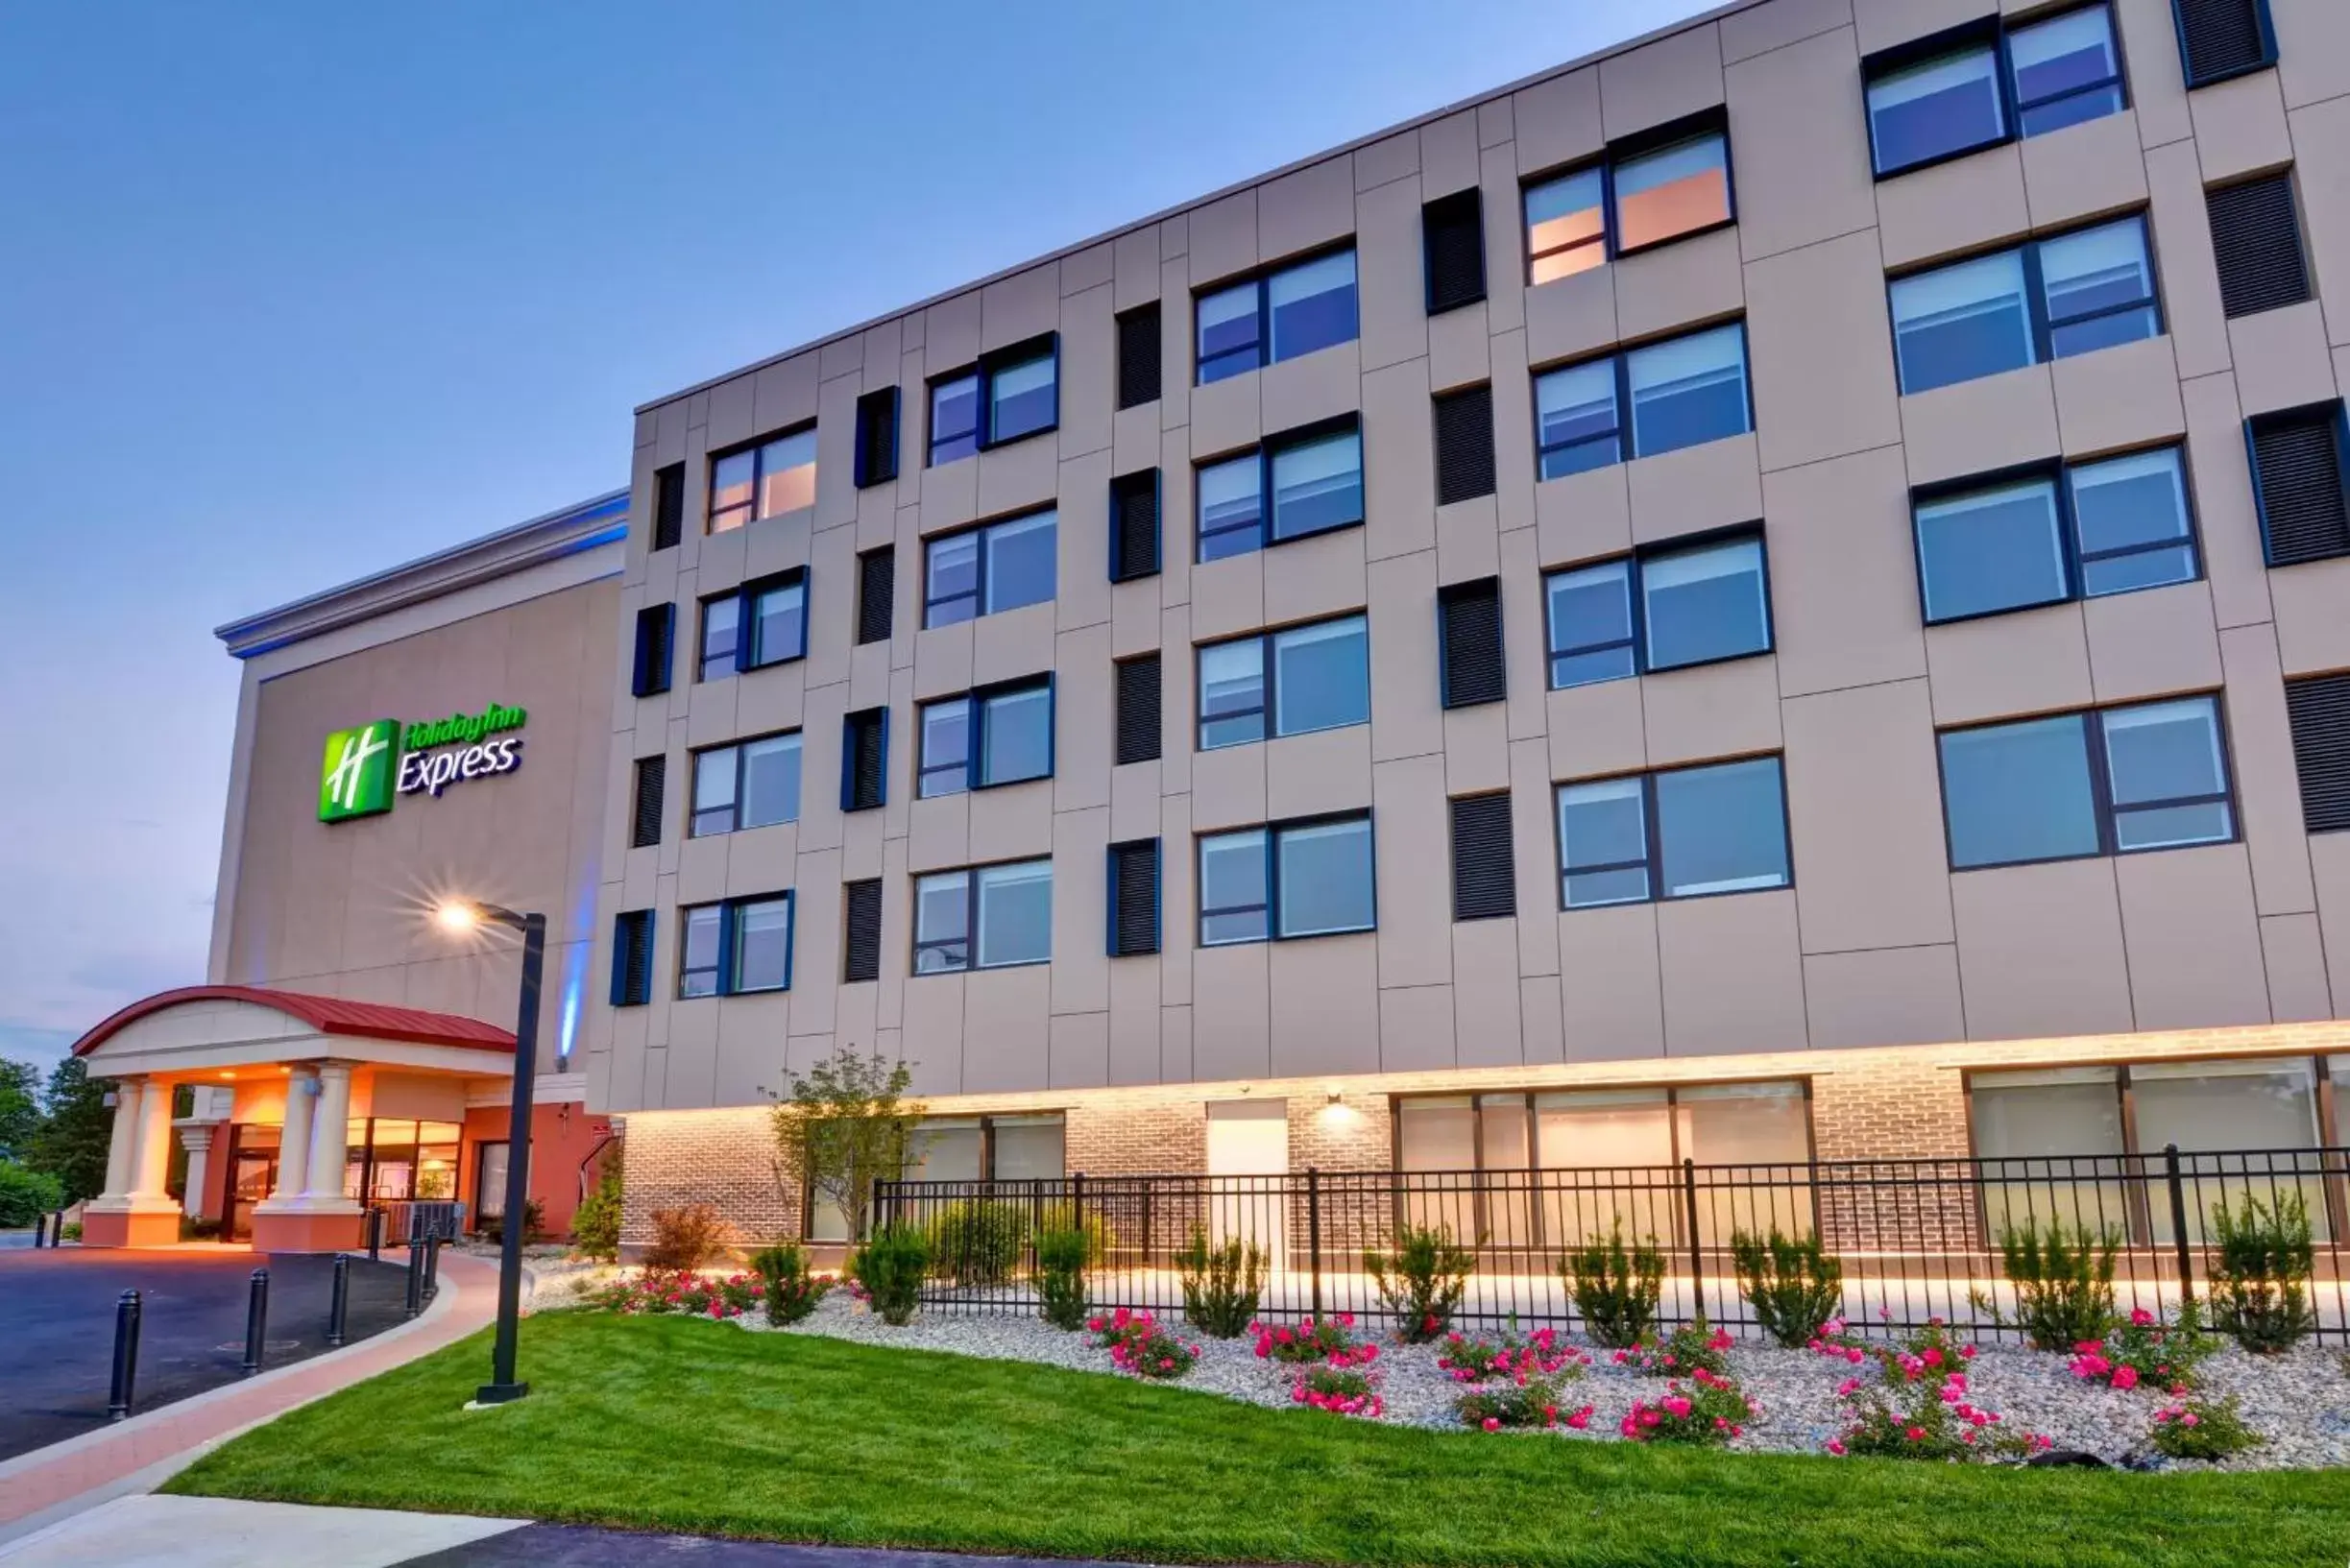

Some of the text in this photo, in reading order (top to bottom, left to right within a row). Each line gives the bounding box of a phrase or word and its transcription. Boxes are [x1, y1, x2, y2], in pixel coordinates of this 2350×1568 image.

[404, 702, 524, 748] Holiday Inn
[397, 737, 519, 795] Express
